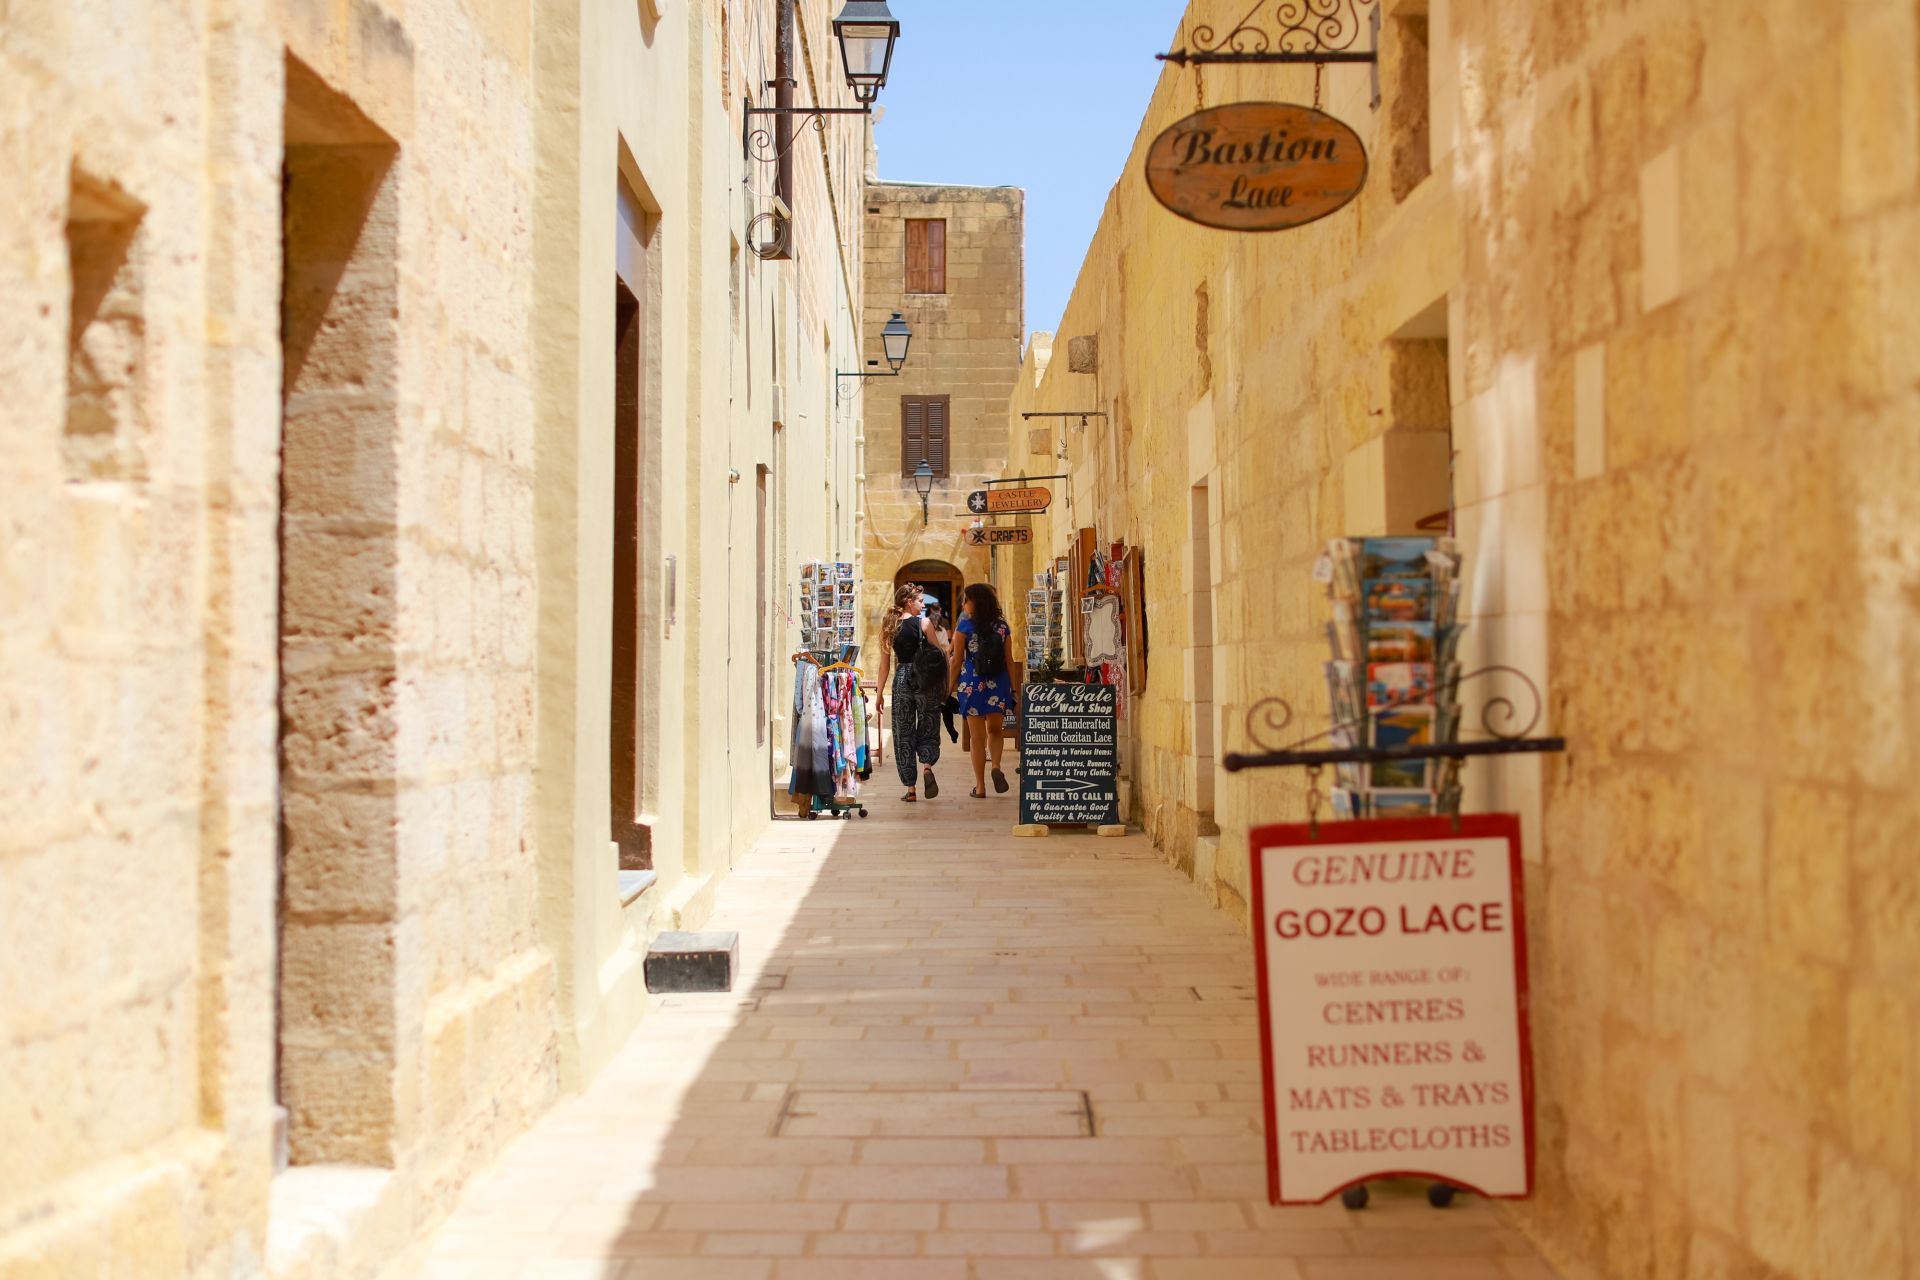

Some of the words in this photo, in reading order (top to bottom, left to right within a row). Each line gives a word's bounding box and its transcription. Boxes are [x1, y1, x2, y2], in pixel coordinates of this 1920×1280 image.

[1171, 127, 1339, 166] Bastion
[1220, 174, 1294, 209] Lace
[998, 490, 1036, 499] CASTLE
[991, 499, 1043, 509] JEWELLERY
[990, 529, 1028, 542] CRAFTS
[1025, 684, 1067, 709] City
[1071, 684, 1112, 702] Gate
[1028, 703, 1051, 713] Lace
[1059, 703, 1085, 713] Work
[1088, 702, 1112, 715] Shop
[1028, 718, 1059, 732] Elegant
[1061, 718, 1110, 730] Handcrafted
[1025, 731, 1059, 742] Genuine
[1061, 731, 1092, 742] Gozitan
[1093, 731, 1112, 742] Lace
[1025, 747, 1060, 757] Specializing
[1062, 748, 1067, 756] in
[1070, 748, 1092, 756] Various
[1093, 748, 1112, 756] Items:
[1043, 759, 1060, 767] Cloth
[1046, 769, 1064, 777] Trays
[1073, 769, 1088, 777] Tray
[1025, 792, 1043, 800] FEEL
[1046, 792, 1065, 800] FREE
[1068, 792, 1079, 800] TO
[1082, 792, 1102, 800] CALL
[1104, 792, 1113, 800] IN
[1029, 803, 1041, 811] We
[1043, 803, 1087, 811] Guarantee
[1089, 803, 1110, 811] Good
[1033, 812, 1065, 822] Quality
[1067, 812, 1074, 820] &
[1077, 812, 1105, 820] Prices!
[1291, 848, 1476, 887] GENUINE
[1274, 905, 1386, 939] GOZO
[1400, 902, 1503, 934] LACE
[1314, 970, 1363, 988] WIDE
[1369, 968, 1431, 987] RANGE
[1322, 997, 1465, 1026] CENTRES
[1306, 1041, 1453, 1068] RUNNERS
[1461, 1039, 1486, 1063] &
[1289, 1086, 1372, 1111] MATS
[1380, 1084, 1403, 1109] &
[1412, 1081, 1510, 1107] TRAYS
[1290, 1125, 1511, 1153] TABLECLOTHS
